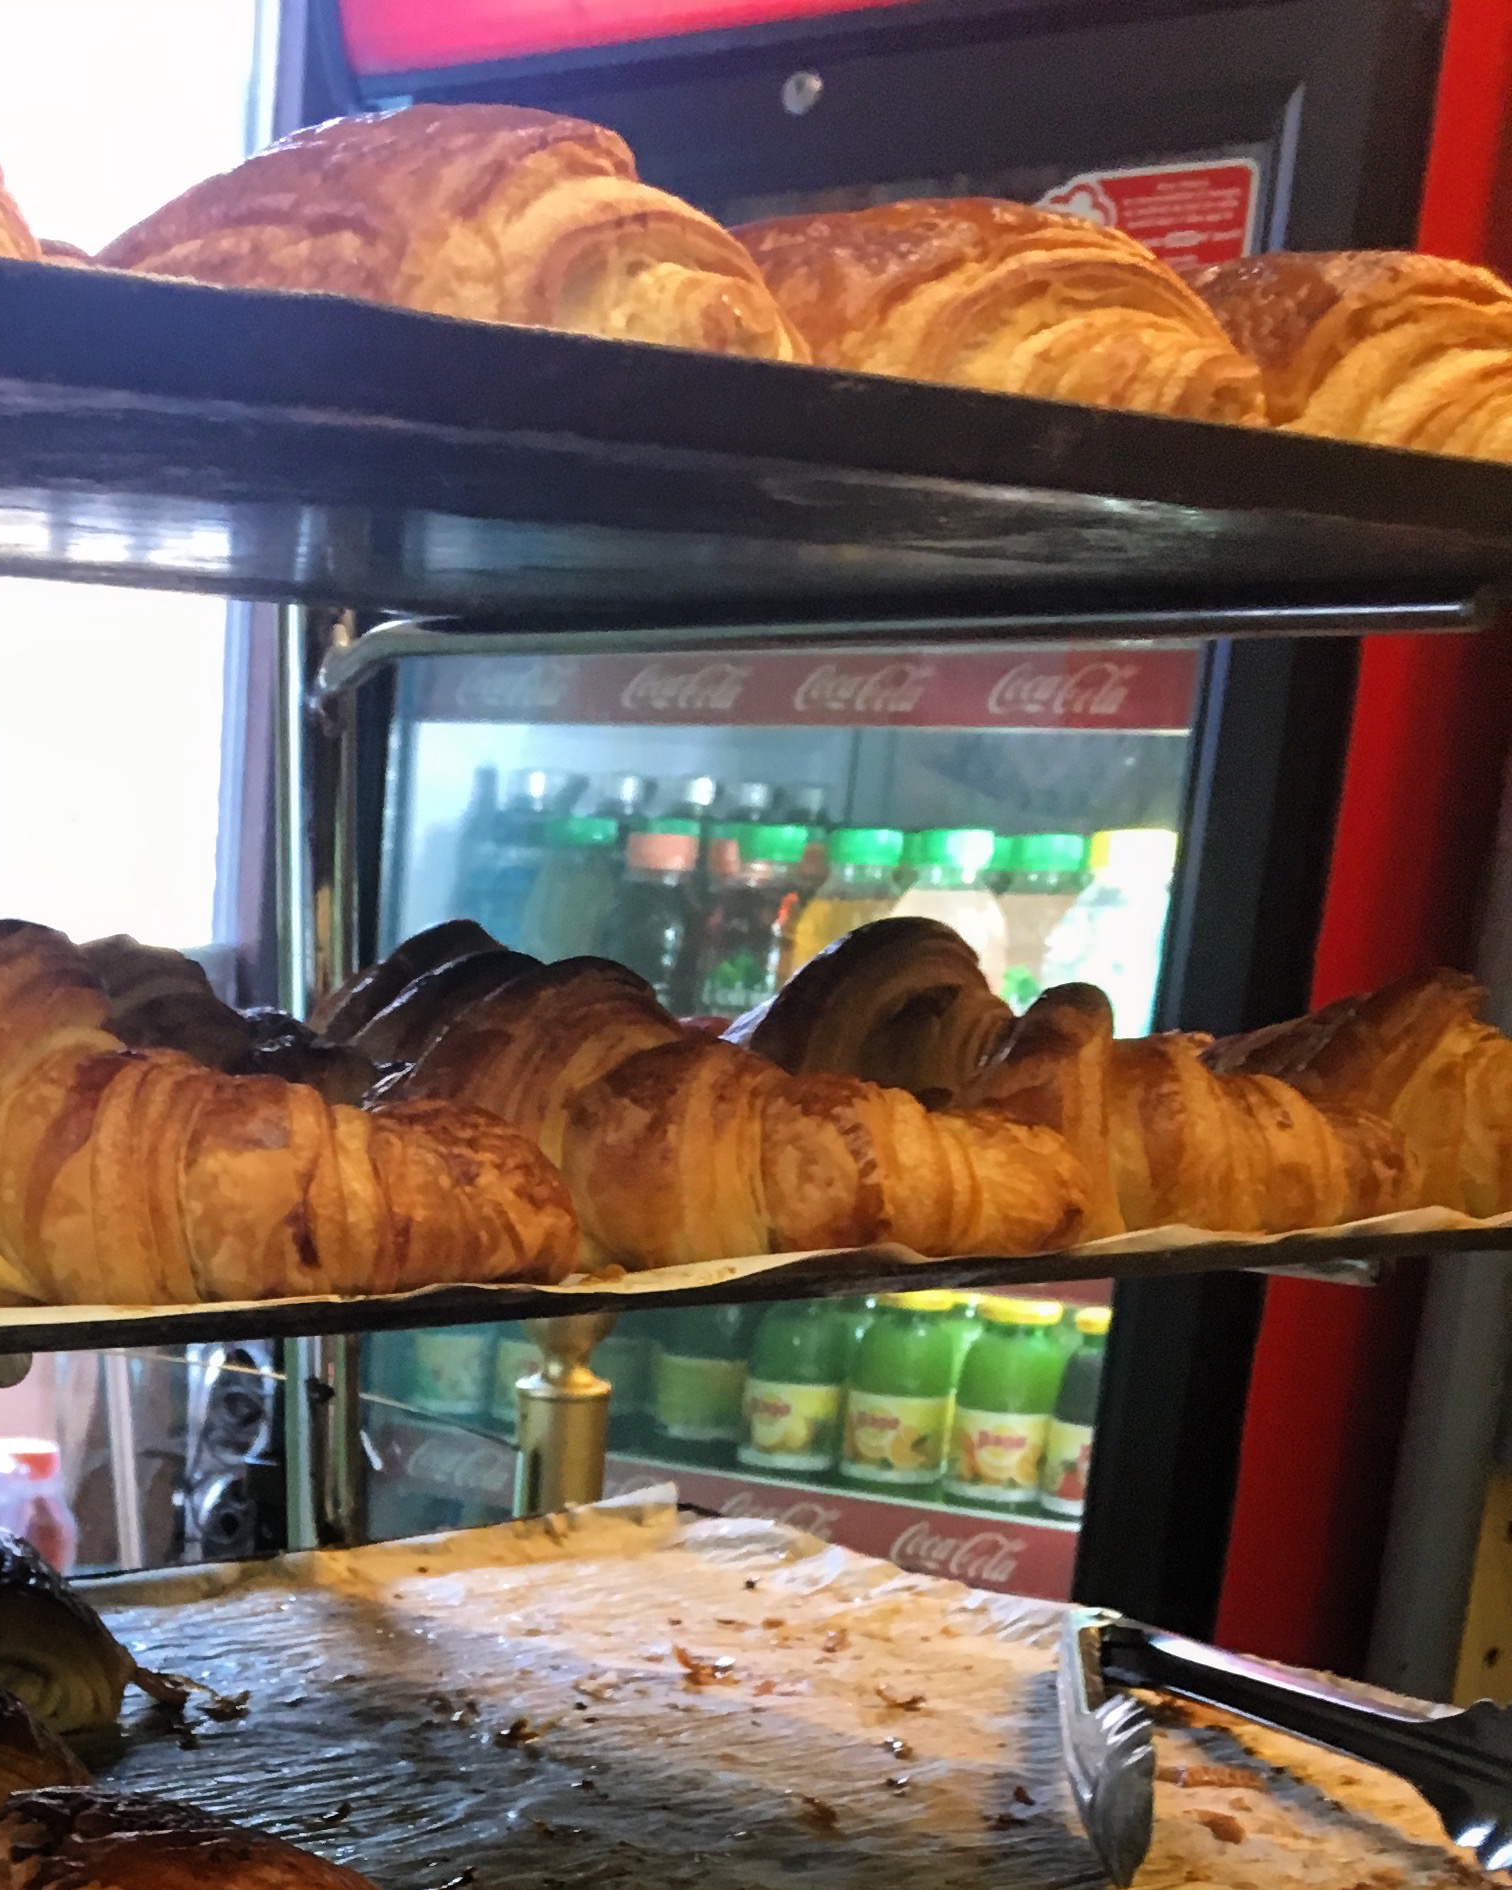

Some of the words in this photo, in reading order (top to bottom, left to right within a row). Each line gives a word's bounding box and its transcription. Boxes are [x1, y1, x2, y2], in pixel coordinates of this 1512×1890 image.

[794, 662, 936, 712] Coca-Cola
[988, 661, 1141, 714] Coca-Cola
[889, 1520, 1028, 1583] Coca-Cola
